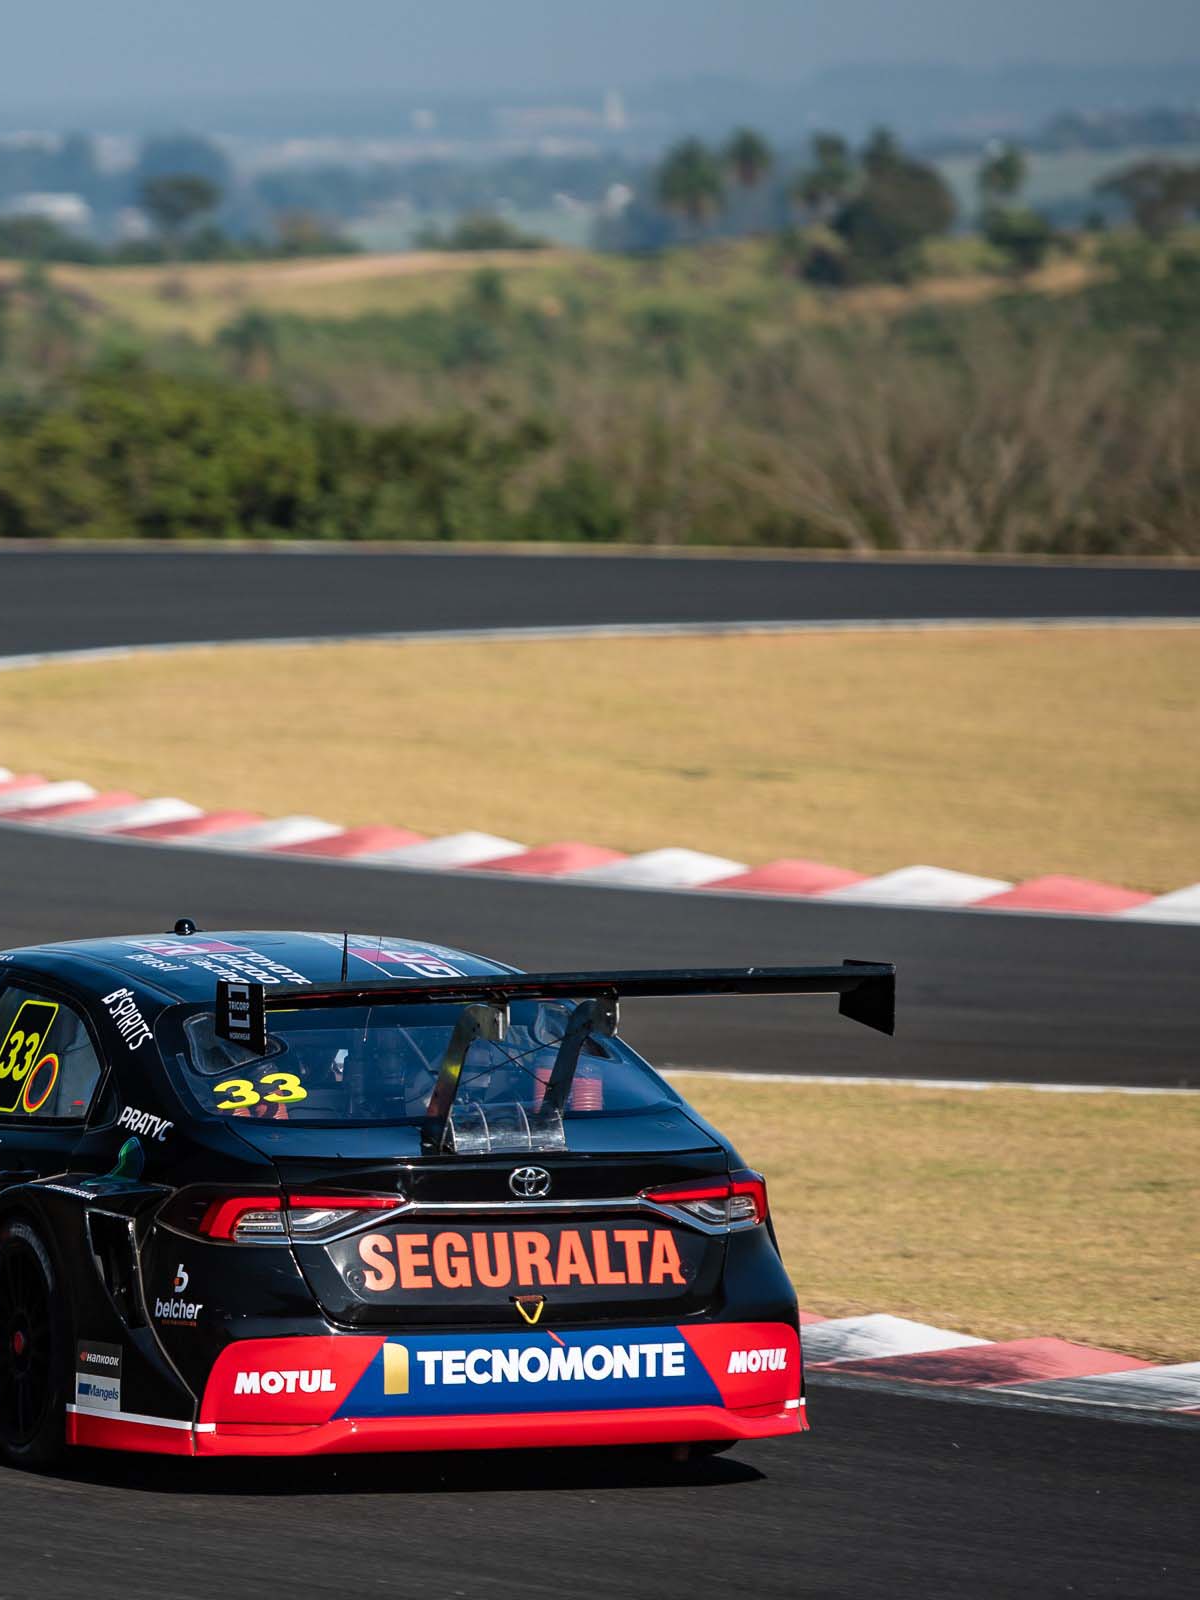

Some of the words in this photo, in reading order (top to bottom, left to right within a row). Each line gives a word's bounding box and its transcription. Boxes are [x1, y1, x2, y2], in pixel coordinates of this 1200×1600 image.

[125, 953, 189, 972] Brasil
[207, 953, 281, 984] GAZOO
[213, 1072, 308, 1110] 33
[358, 1229, 687, 1291] SEGURALTA
[155, 1297, 203, 1320] belcher
[417, 1342, 686, 1386] TECNOMONTE
[727, 1347, 788, 1374] MOTUL
[88, 1383, 119, 1401] Mangels
[234, 1368, 336, 1395] MOTUL
